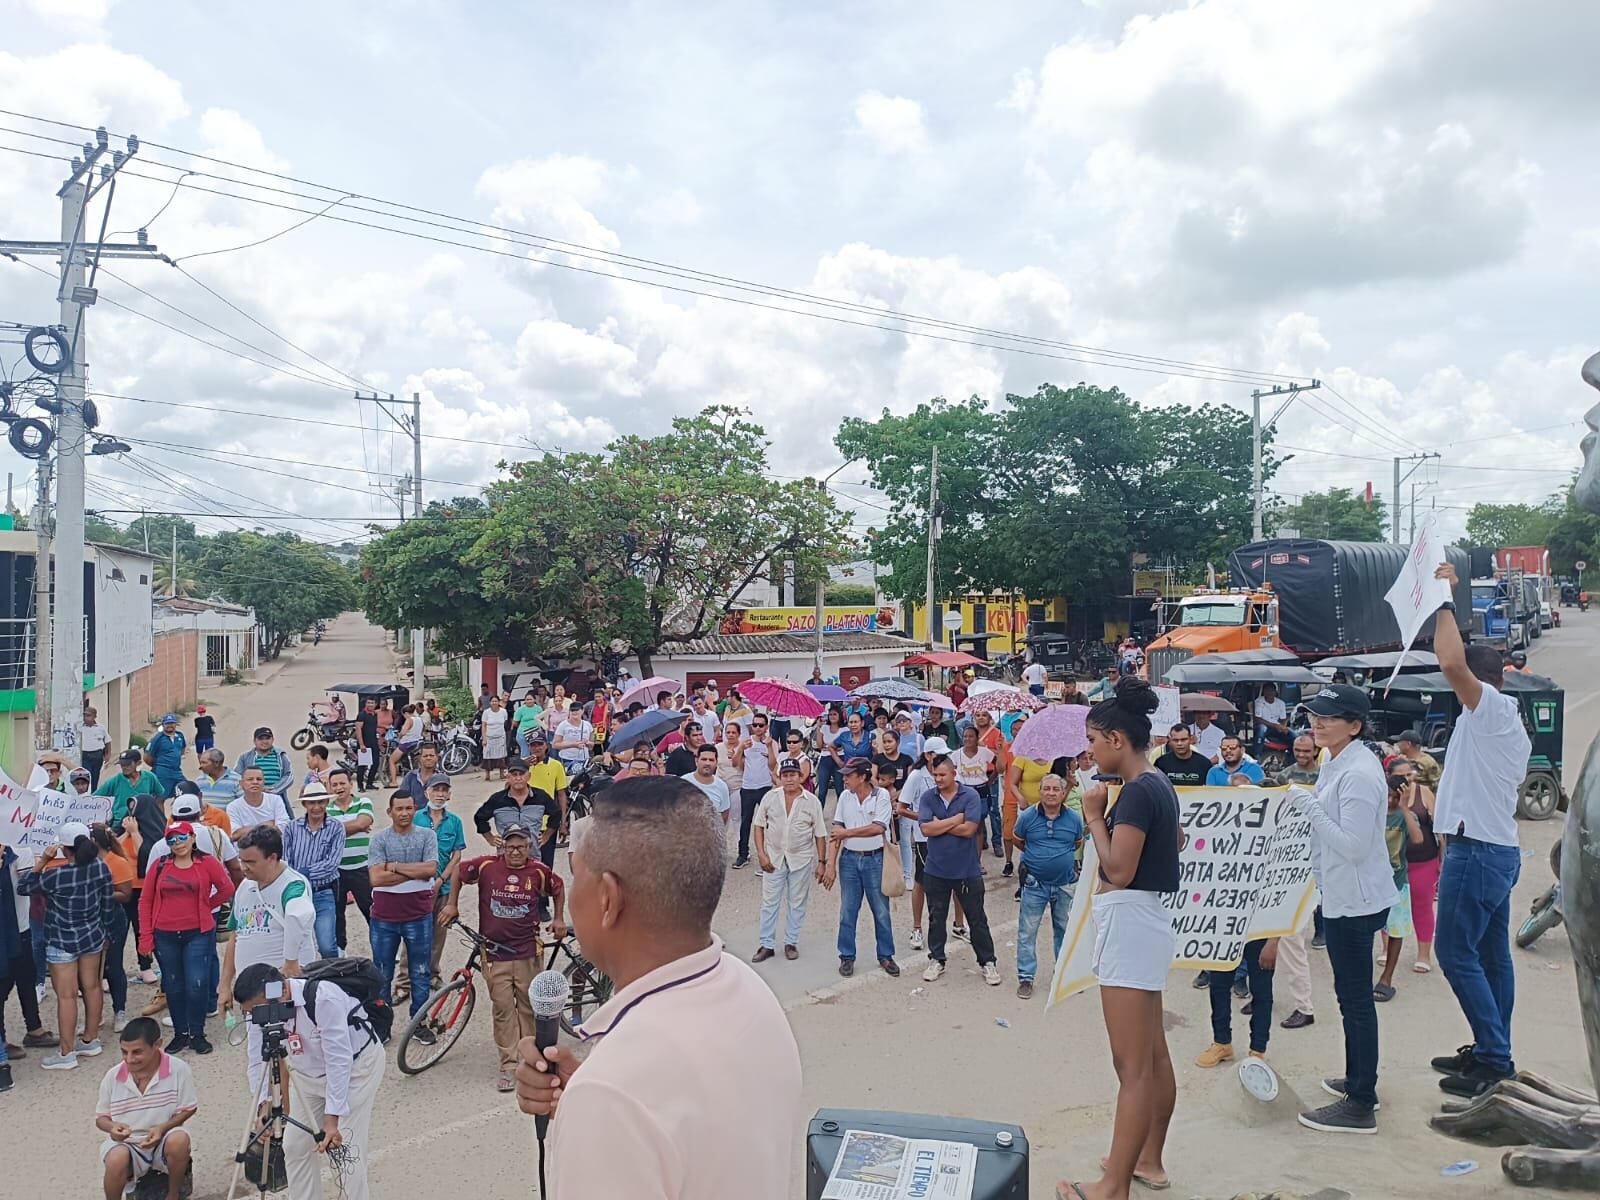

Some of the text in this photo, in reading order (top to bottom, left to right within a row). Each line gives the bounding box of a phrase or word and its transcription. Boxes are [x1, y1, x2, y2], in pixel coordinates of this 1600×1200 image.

[749, 613, 784, 622] Restaurante
[917, 1150, 935, 1163] EL
[907, 1165, 933, 1198] TIEMPO
